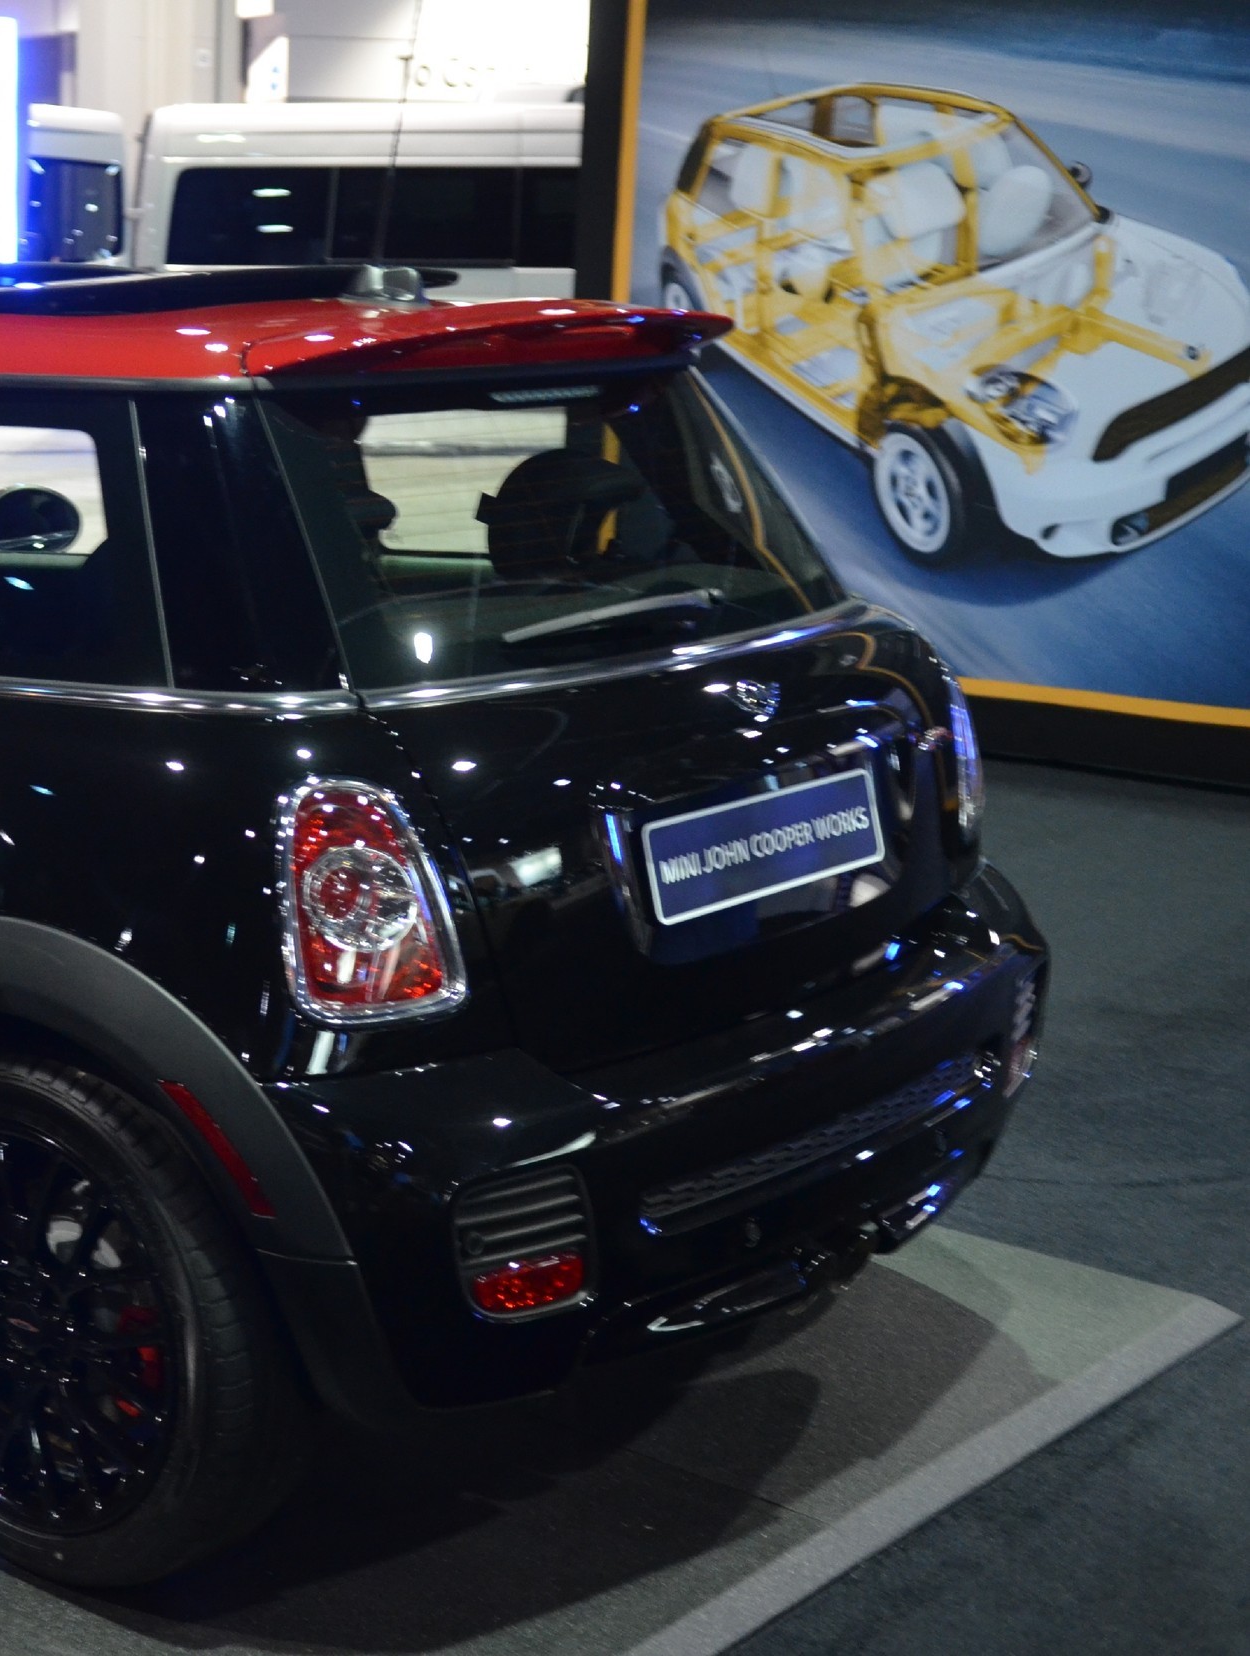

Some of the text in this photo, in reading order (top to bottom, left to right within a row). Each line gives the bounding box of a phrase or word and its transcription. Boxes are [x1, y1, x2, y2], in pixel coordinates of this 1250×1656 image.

[658, 806, 870, 885] MINI JOHN COOPER WORKS
